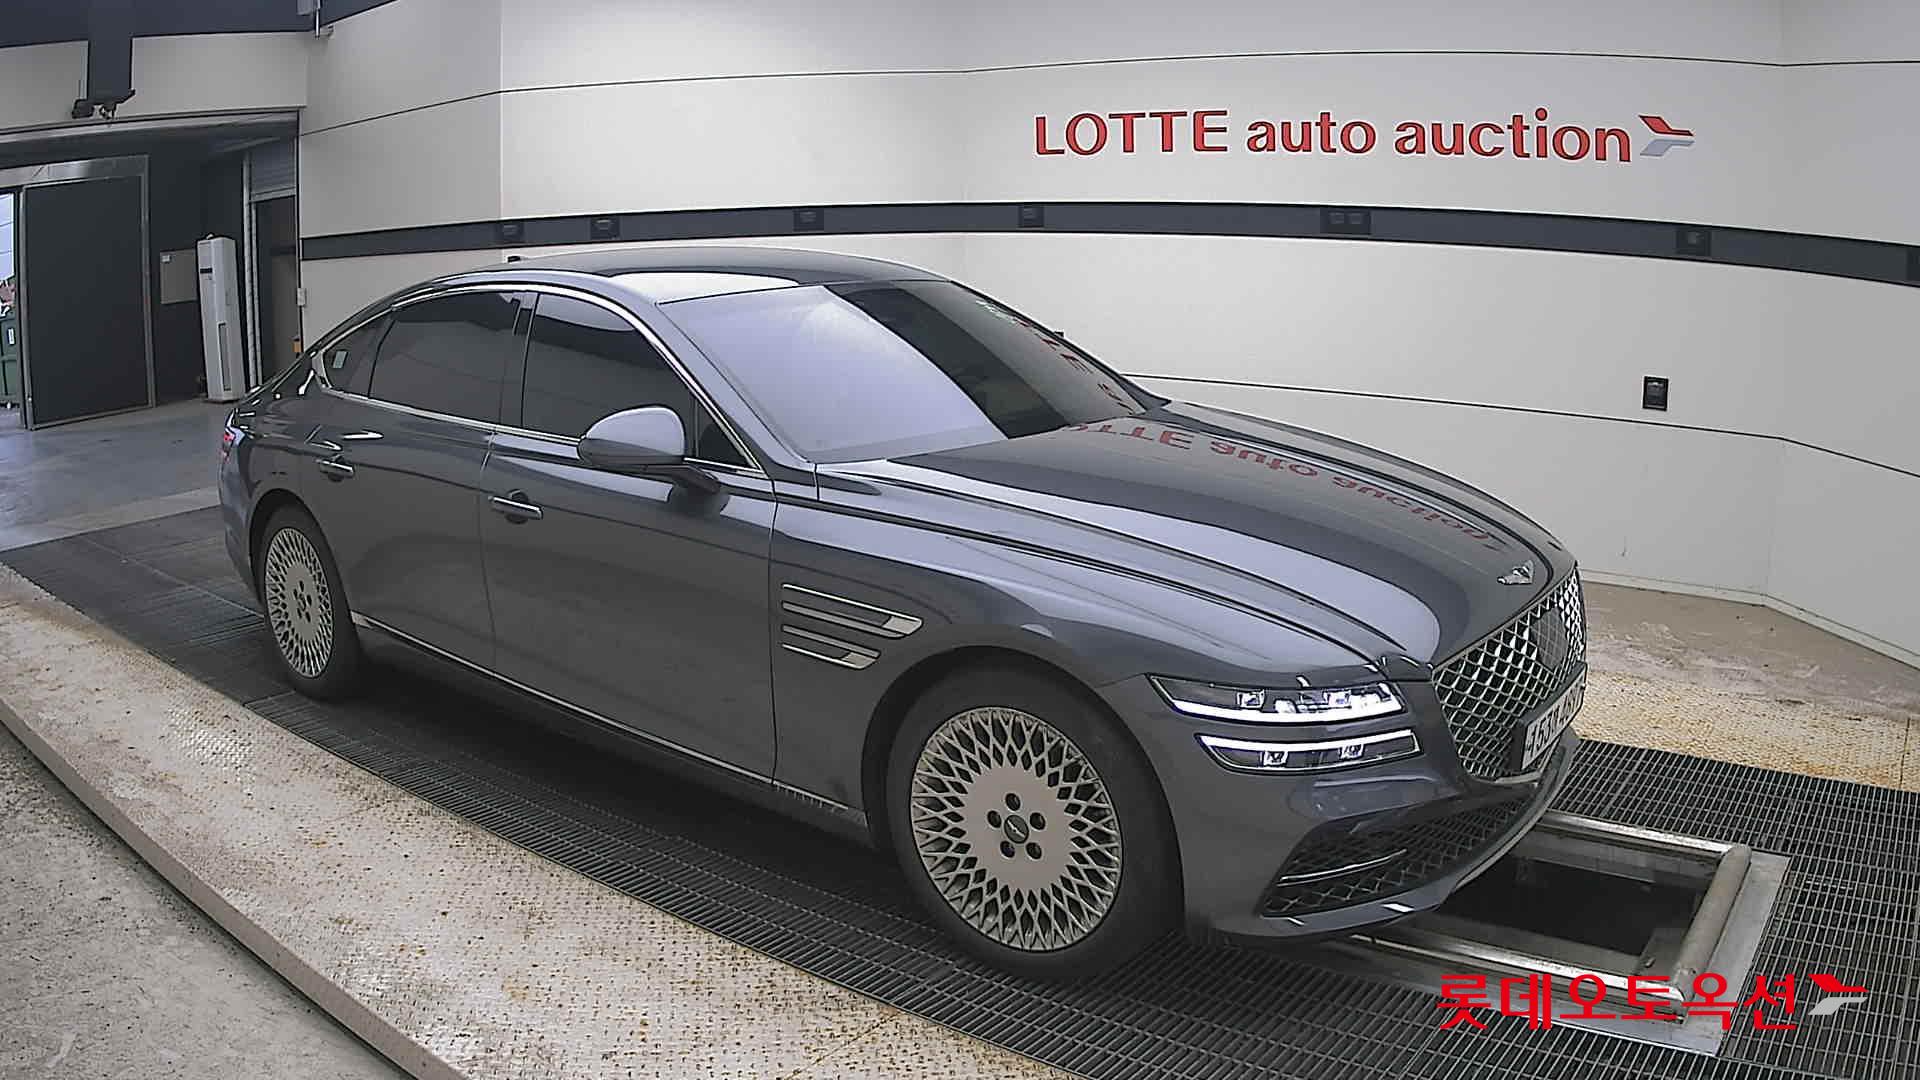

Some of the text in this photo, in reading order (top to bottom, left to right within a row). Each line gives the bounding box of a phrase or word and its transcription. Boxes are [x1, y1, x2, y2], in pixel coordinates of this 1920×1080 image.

[1035, 108, 1631, 163] LOTTE auto auction
